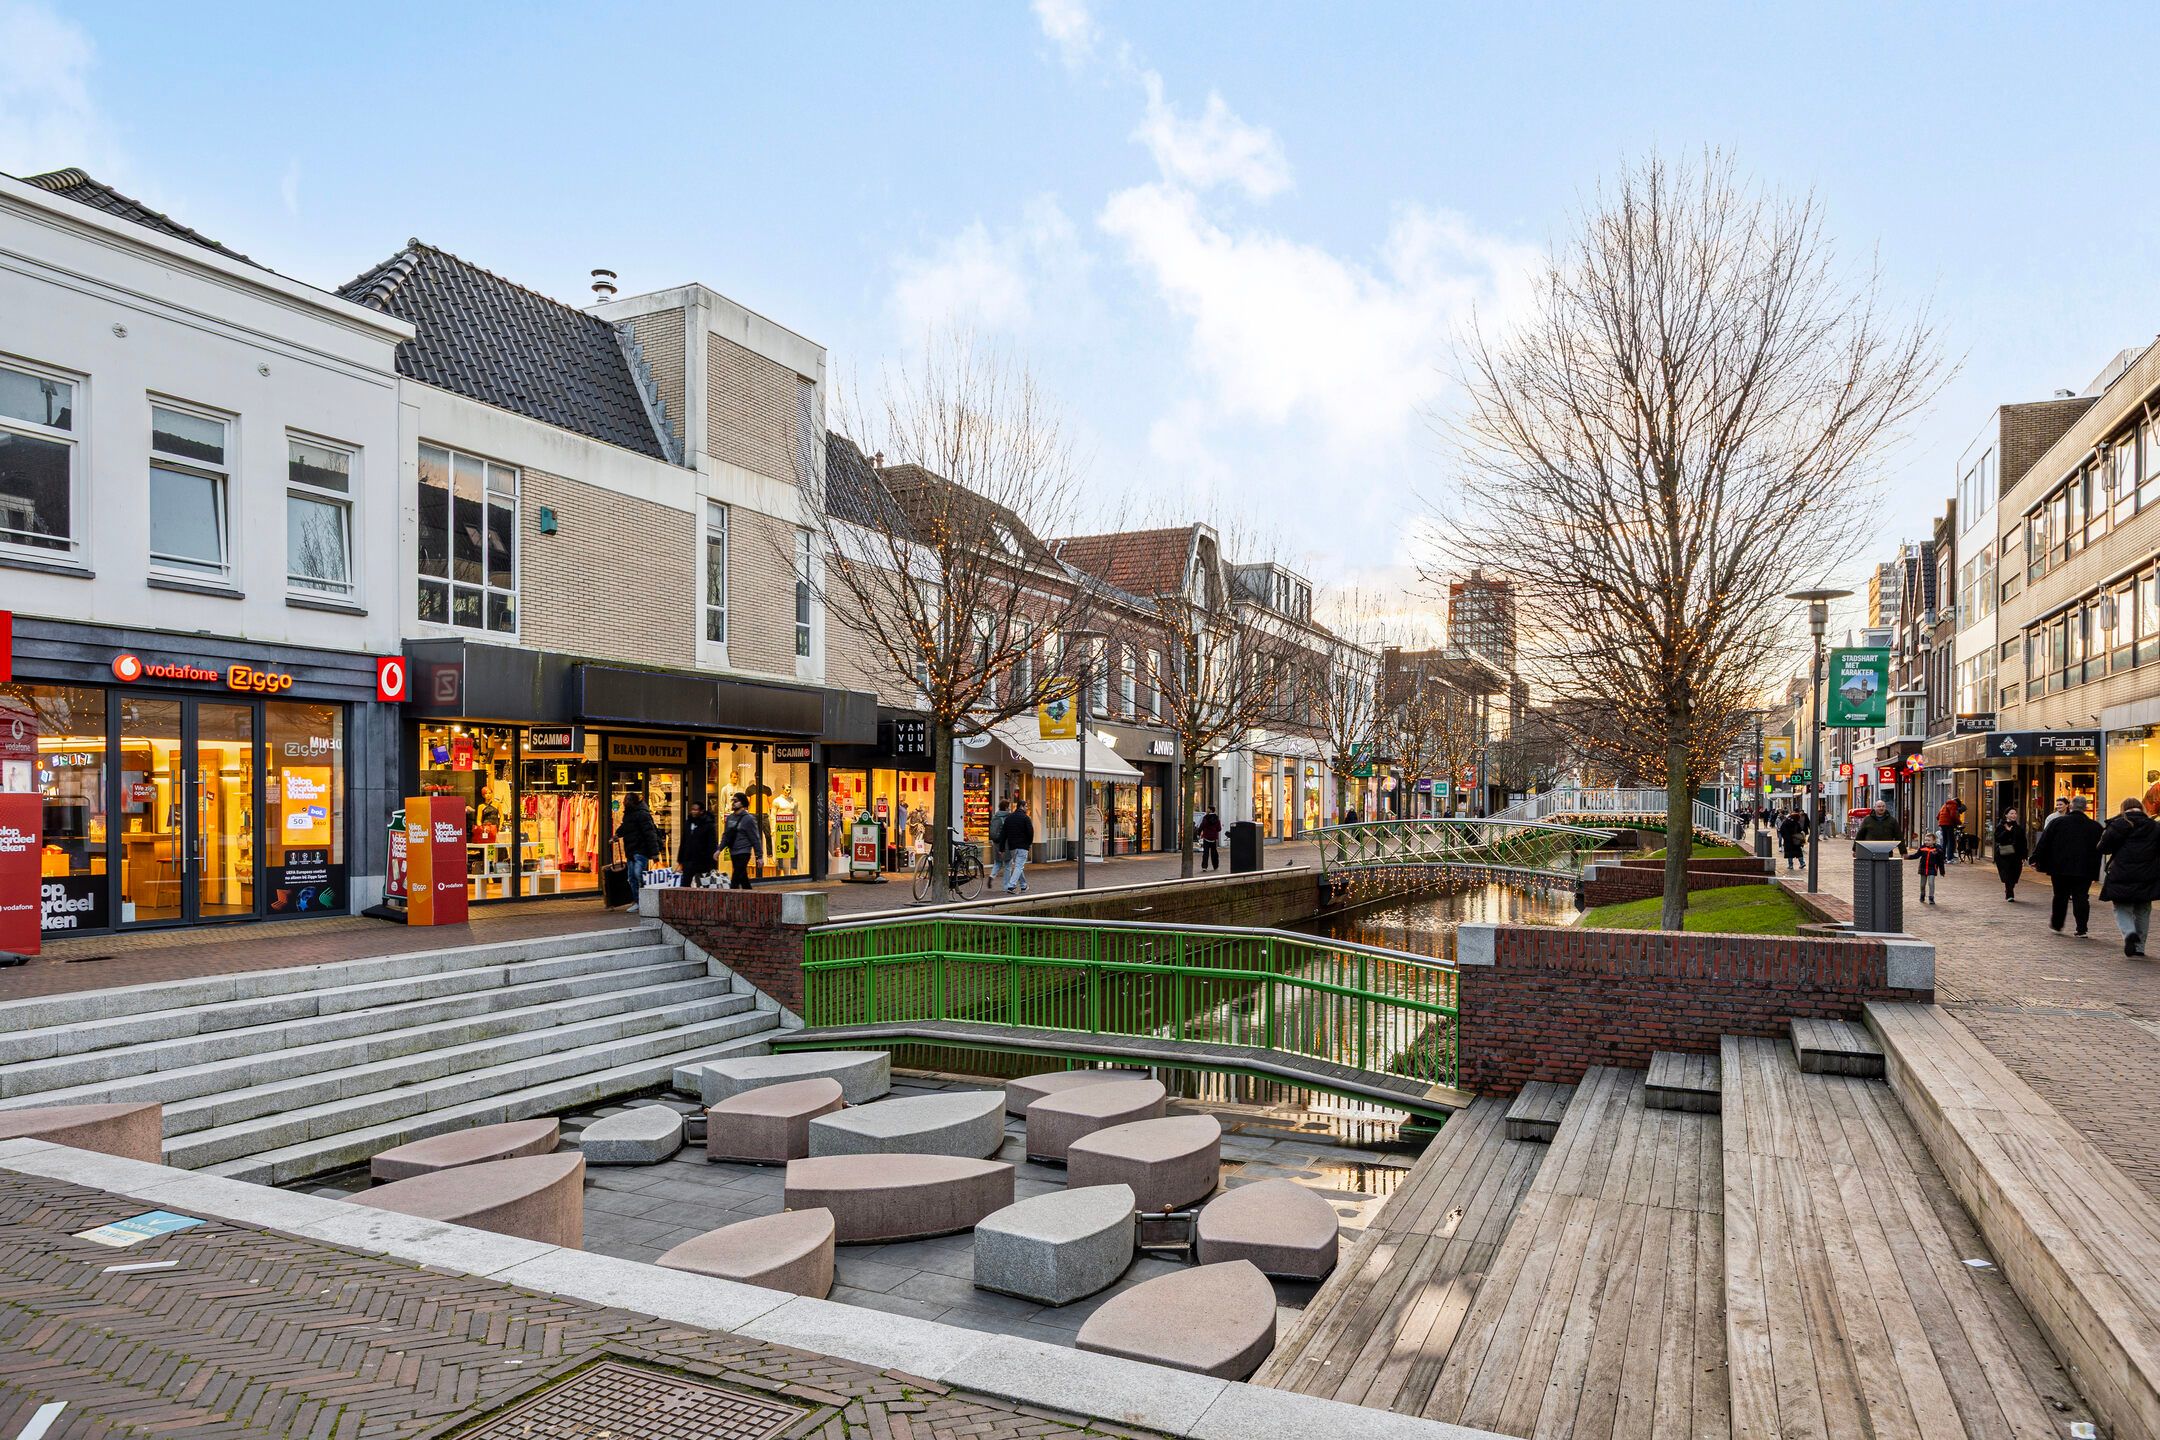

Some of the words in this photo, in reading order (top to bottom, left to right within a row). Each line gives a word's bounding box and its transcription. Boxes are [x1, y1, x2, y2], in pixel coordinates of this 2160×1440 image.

[145, 664, 218, 681] vodafone
[227, 665, 293, 692] Ziggo
[1956, 717, 1995, 726] Pfannin
[898, 723, 924, 731] VAN
[898, 733, 924, 742] VUU
[2040, 735, 2095, 747] Pfannini
[5, 743, 31, 752] vodafone
[613, 743, 647, 756] BRAND
[648, 745, 684, 758] OUTLET
[898, 743, 924, 752] REN
[1153, 740, 1174, 756] ANWB
[287, 777, 313, 785] Volop
[287, 784, 325, 792] Voordeel
[287, 791, 318, 799] Weken
[435, 822, 454, 830] Volop
[435, 828, 463, 836] Voordeel
[435, 835, 458, 843] Weken
[0, 843, 26, 852] eken
[857, 845, 873, 857] €1,-
[3, 903, 34, 911] vodafone
